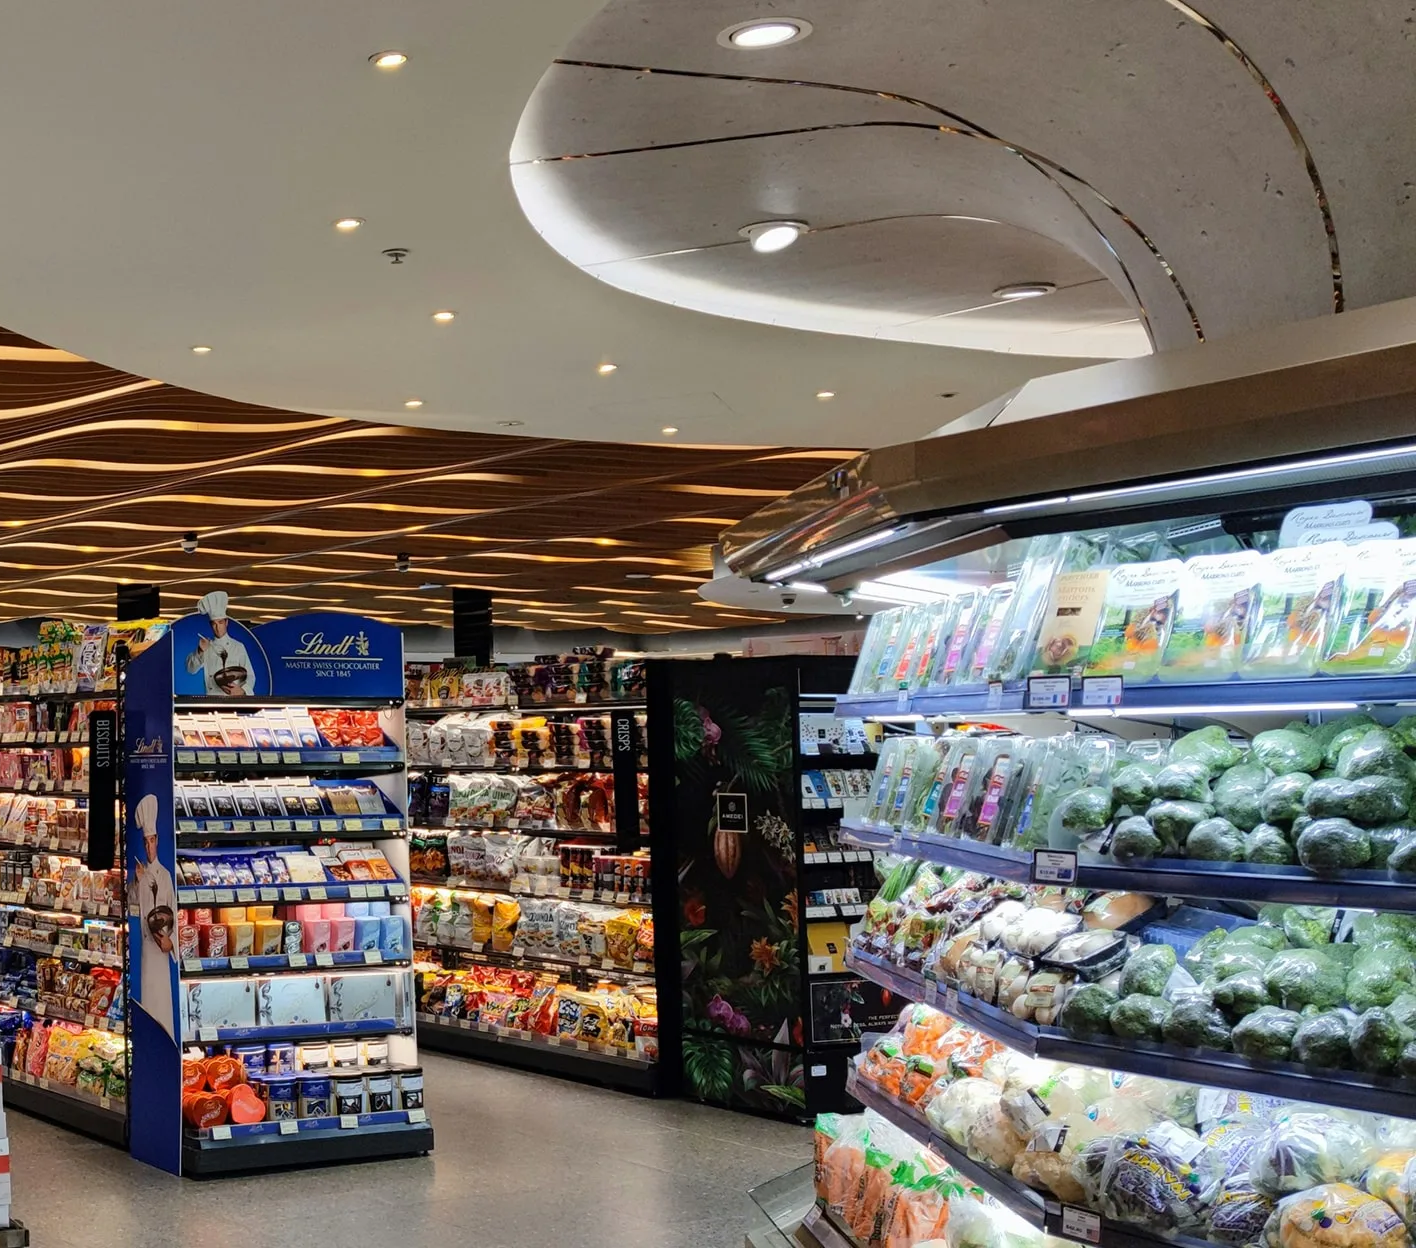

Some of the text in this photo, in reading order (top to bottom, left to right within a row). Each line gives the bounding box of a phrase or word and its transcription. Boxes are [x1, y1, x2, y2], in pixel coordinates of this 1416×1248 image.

[295, 632, 355, 655] Lindt
[313, 662, 332, 670] SWISS
[334, 662, 380, 670] CHOCOLATIER
[96, 719, 110, 767] BISCUITS
[617, 718, 630, 751] CRISPS
